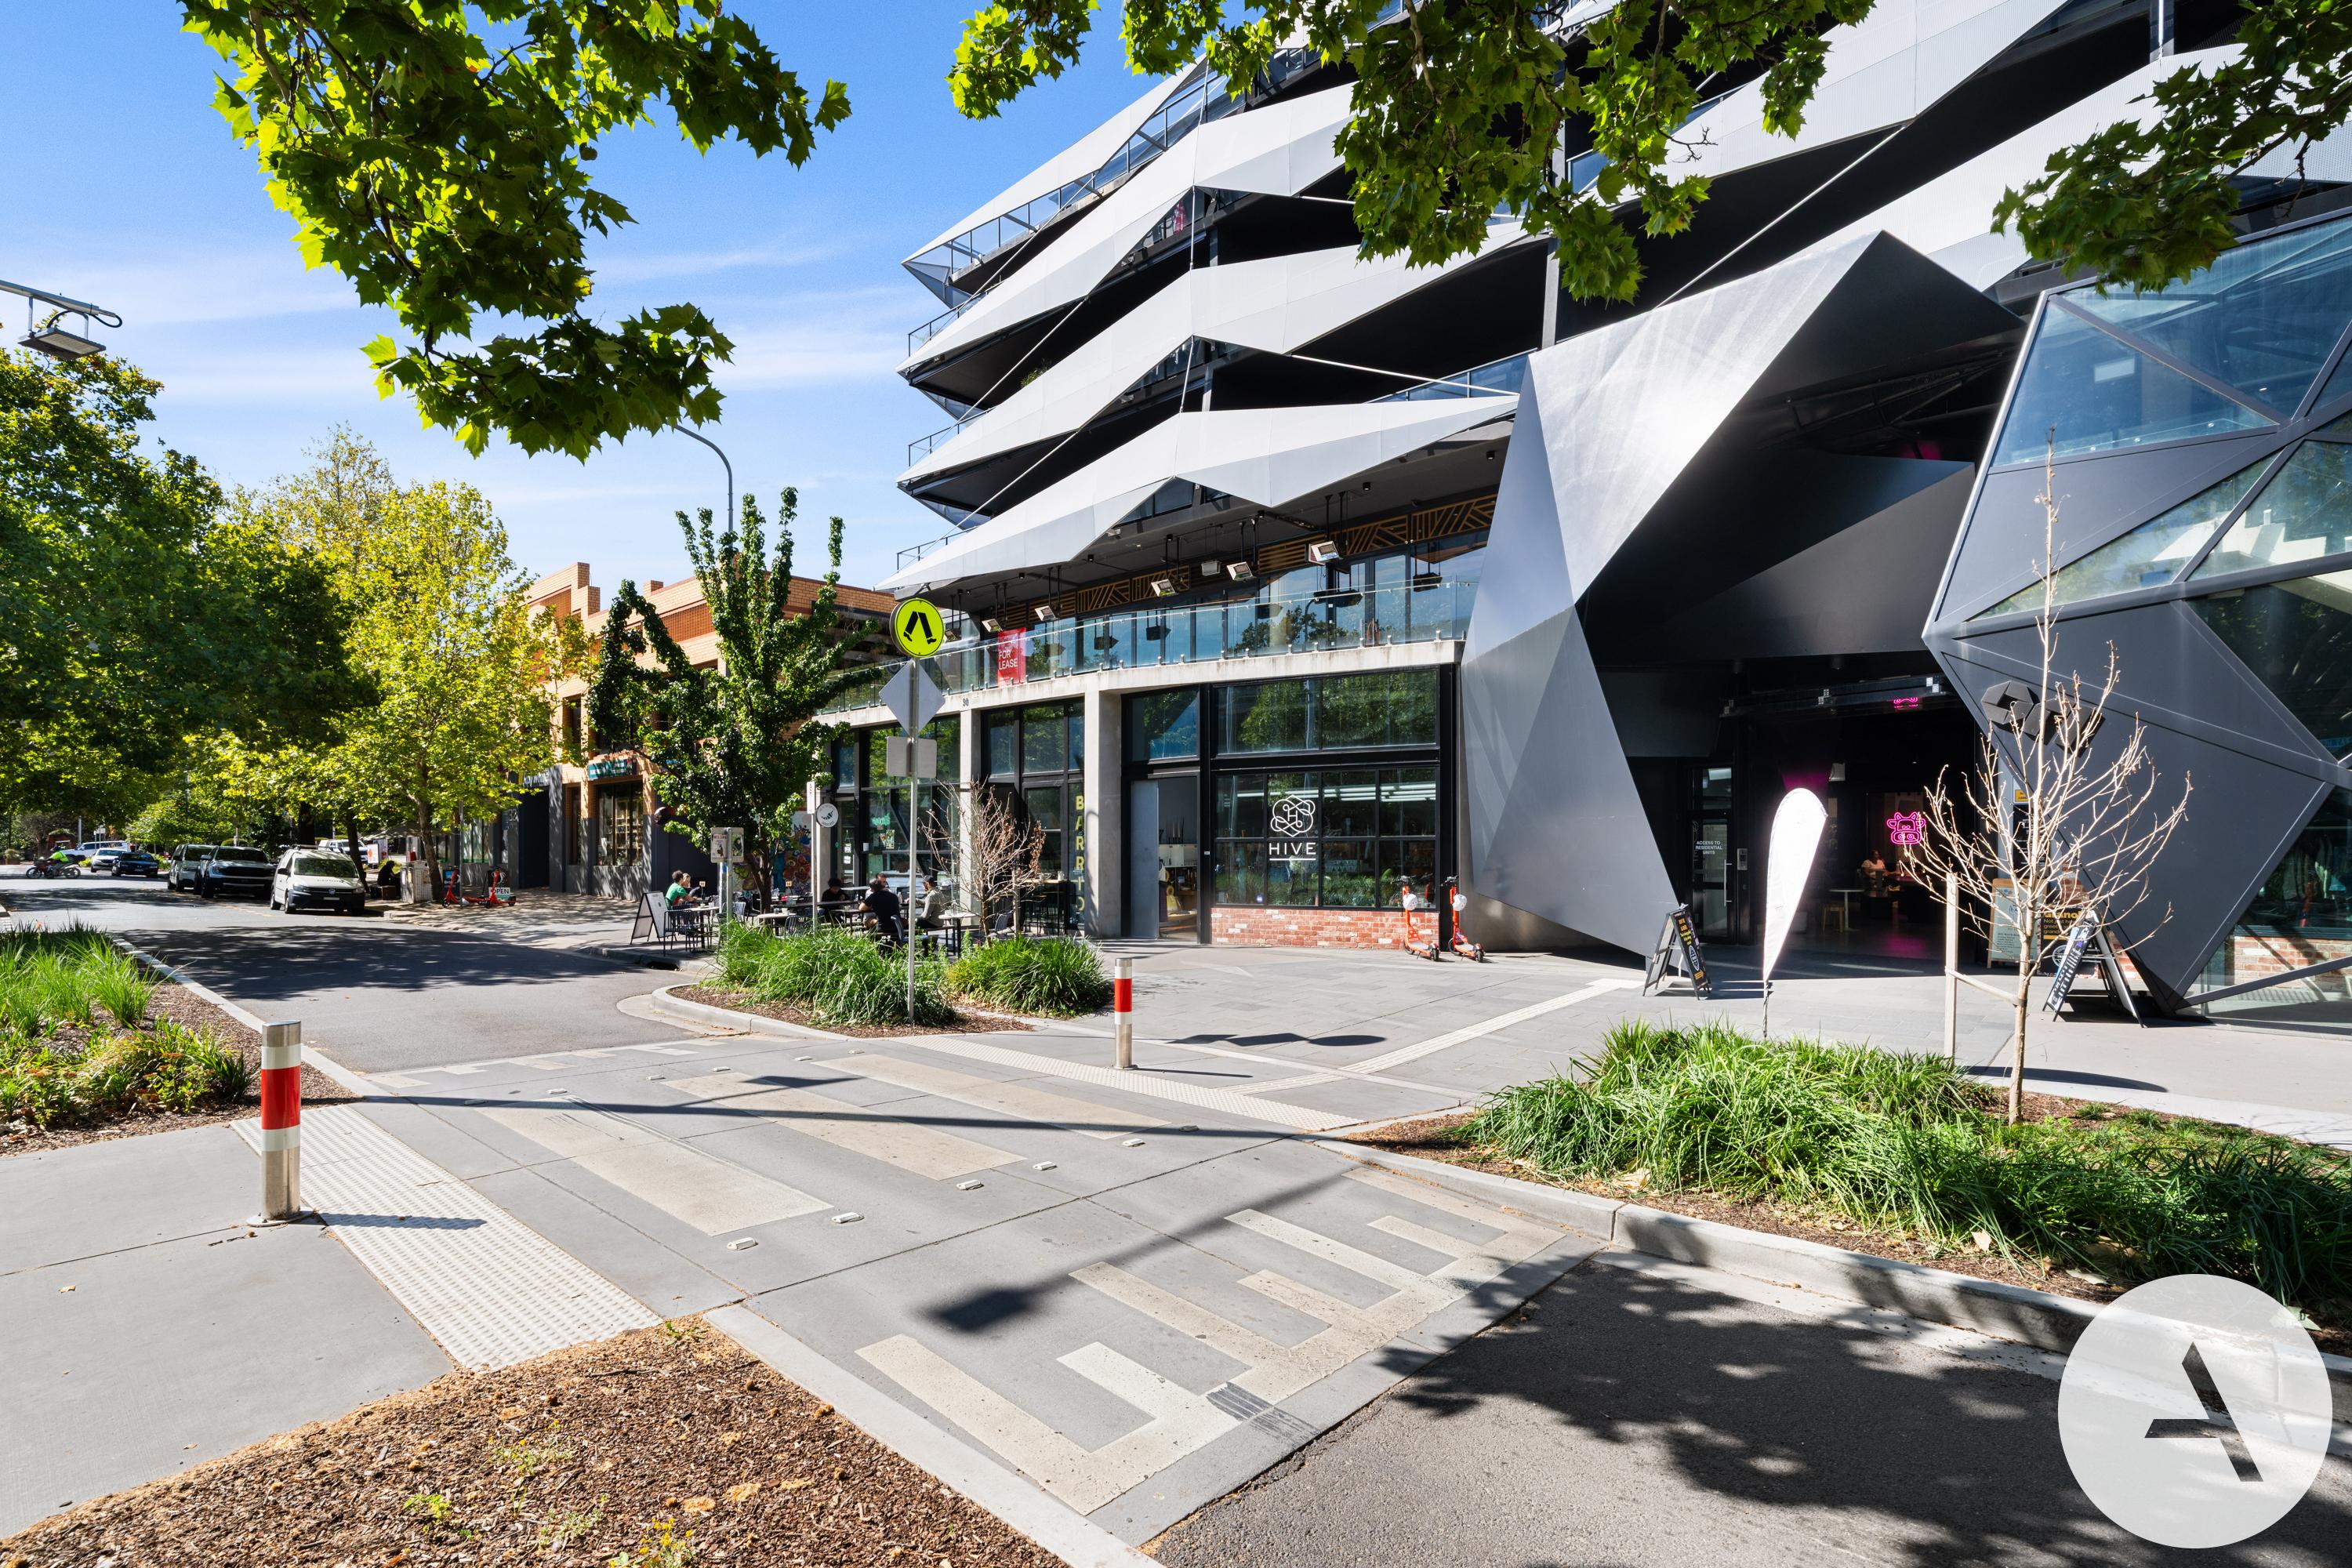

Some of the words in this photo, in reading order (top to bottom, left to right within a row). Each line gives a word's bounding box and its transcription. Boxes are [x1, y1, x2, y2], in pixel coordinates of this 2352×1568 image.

[999, 650, 1011, 660] FOR
[999, 658, 1018, 670] LEASE
[1269, 842, 1316, 855] HIVE
